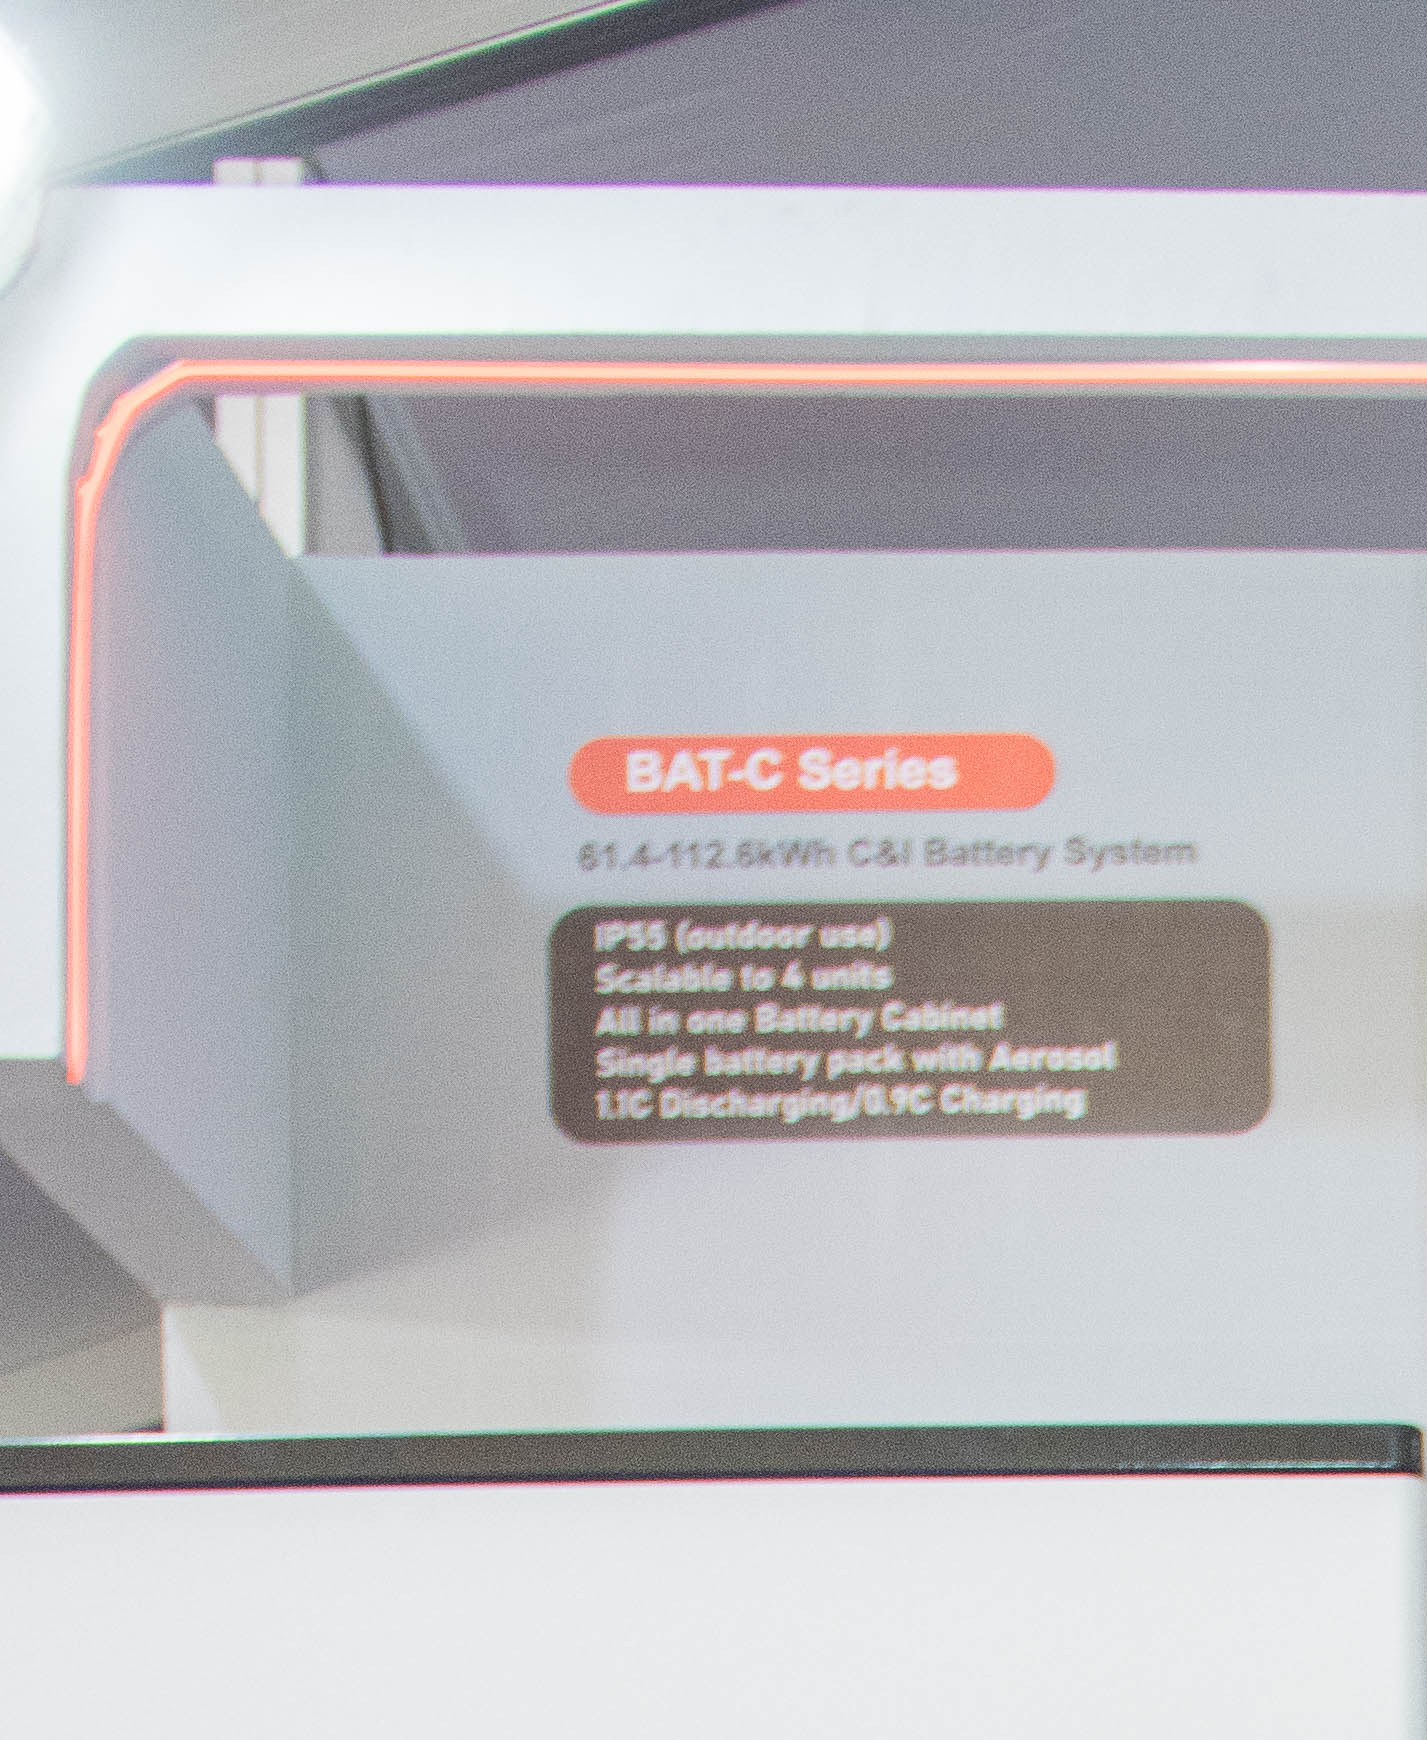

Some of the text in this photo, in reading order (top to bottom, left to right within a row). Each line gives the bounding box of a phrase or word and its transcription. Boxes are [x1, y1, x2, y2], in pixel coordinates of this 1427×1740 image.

[627, 747, 958, 792] BAT-C Series
[847, 838, 912, 867] C&I
[924, 837, 1052, 871] Battery
[1065, 835, 1198, 872] System
[596, 917, 891, 952] IP55 (outdoor use)
[597, 961, 893, 993] Scalable to 4 units
[597, 1001, 1003, 1038] All in one Battery Cabinet
[597, 1041, 1116, 1083] Single battery pack with Aerosol
[941, 1084, 1086, 1120] Charging
